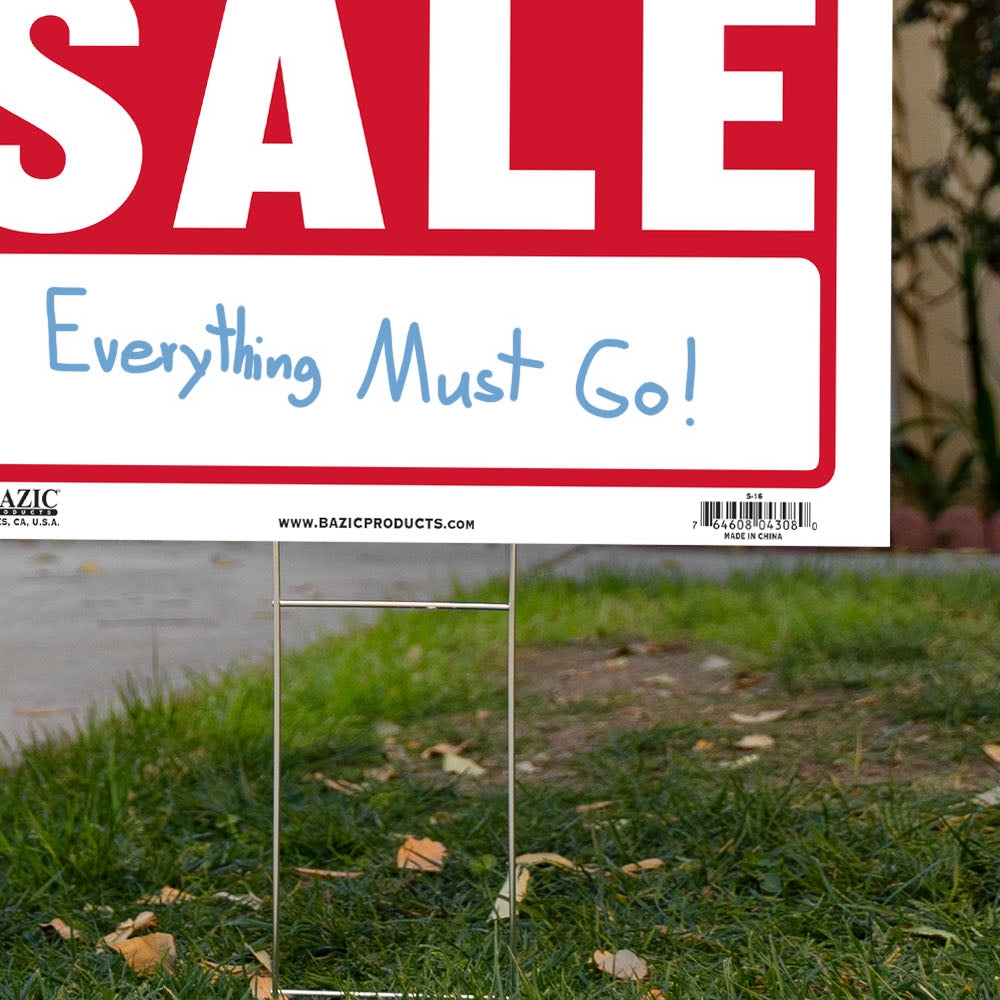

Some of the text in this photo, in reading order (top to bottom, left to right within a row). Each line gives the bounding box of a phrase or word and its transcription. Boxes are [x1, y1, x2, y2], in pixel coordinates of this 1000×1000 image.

[46, 287, 696, 426] Everything Must Go!
[746, 492, 763, 500] S-16
[13, 517, 29, 527] CA,
[32, 518, 60, 527] U.S.A.
[692, 519, 818, 531] 7 64608 04308 0
[724, 532, 783, 540] MADE IN CHINA
